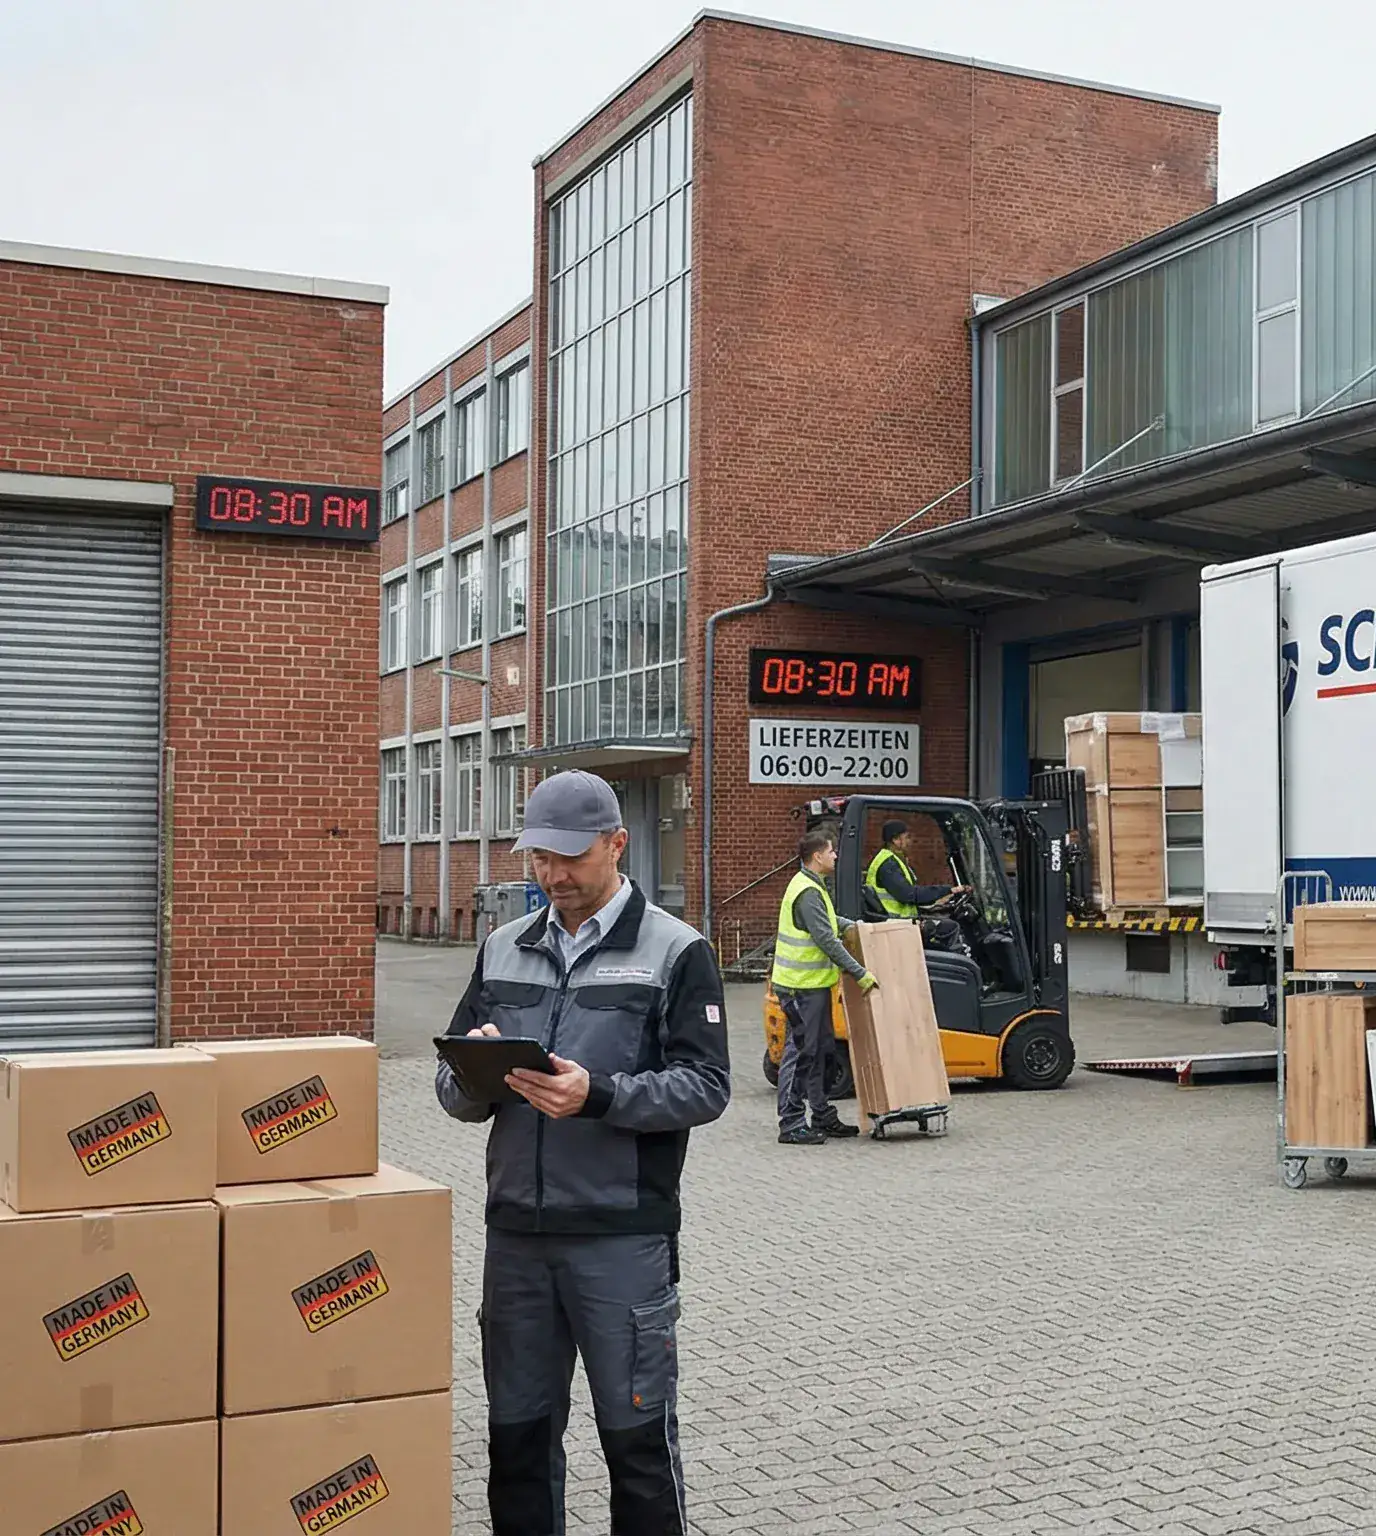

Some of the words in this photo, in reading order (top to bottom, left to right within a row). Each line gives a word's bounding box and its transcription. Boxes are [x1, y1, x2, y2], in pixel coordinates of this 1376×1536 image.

[209, 486, 312, 526] 08:30
[322, 495, 368, 530] AM
[762, 658, 858, 697] 08:30
[867, 663, 911, 697] AM
[759, 726, 909, 750] LIEFERZEITEN
[76, 1110, 132, 1149] MADE
[132, 1099, 155, 1121] IN
[249, 1092, 301, 1129] MADE
[300, 1083, 321, 1103] IN
[259, 1102, 329, 1146] GERMANY
[86, 1120, 161, 1168] GERMANY
[300, 1270, 352, 1307] MADE
[352, 1258, 372, 1279] IN
[309, 1276, 380, 1325] GERMANY
[52, 1292, 109, 1334] MADE
[109, 1280, 131, 1303] IN
[61, 1300, 140, 1352] GERMANY
[103, 1498, 126, 1520] IN
[297, 1474, 352, 1515] MADE
[351, 1462, 372, 1483] IN
[307, 1479, 378, 1533] GERMANY
